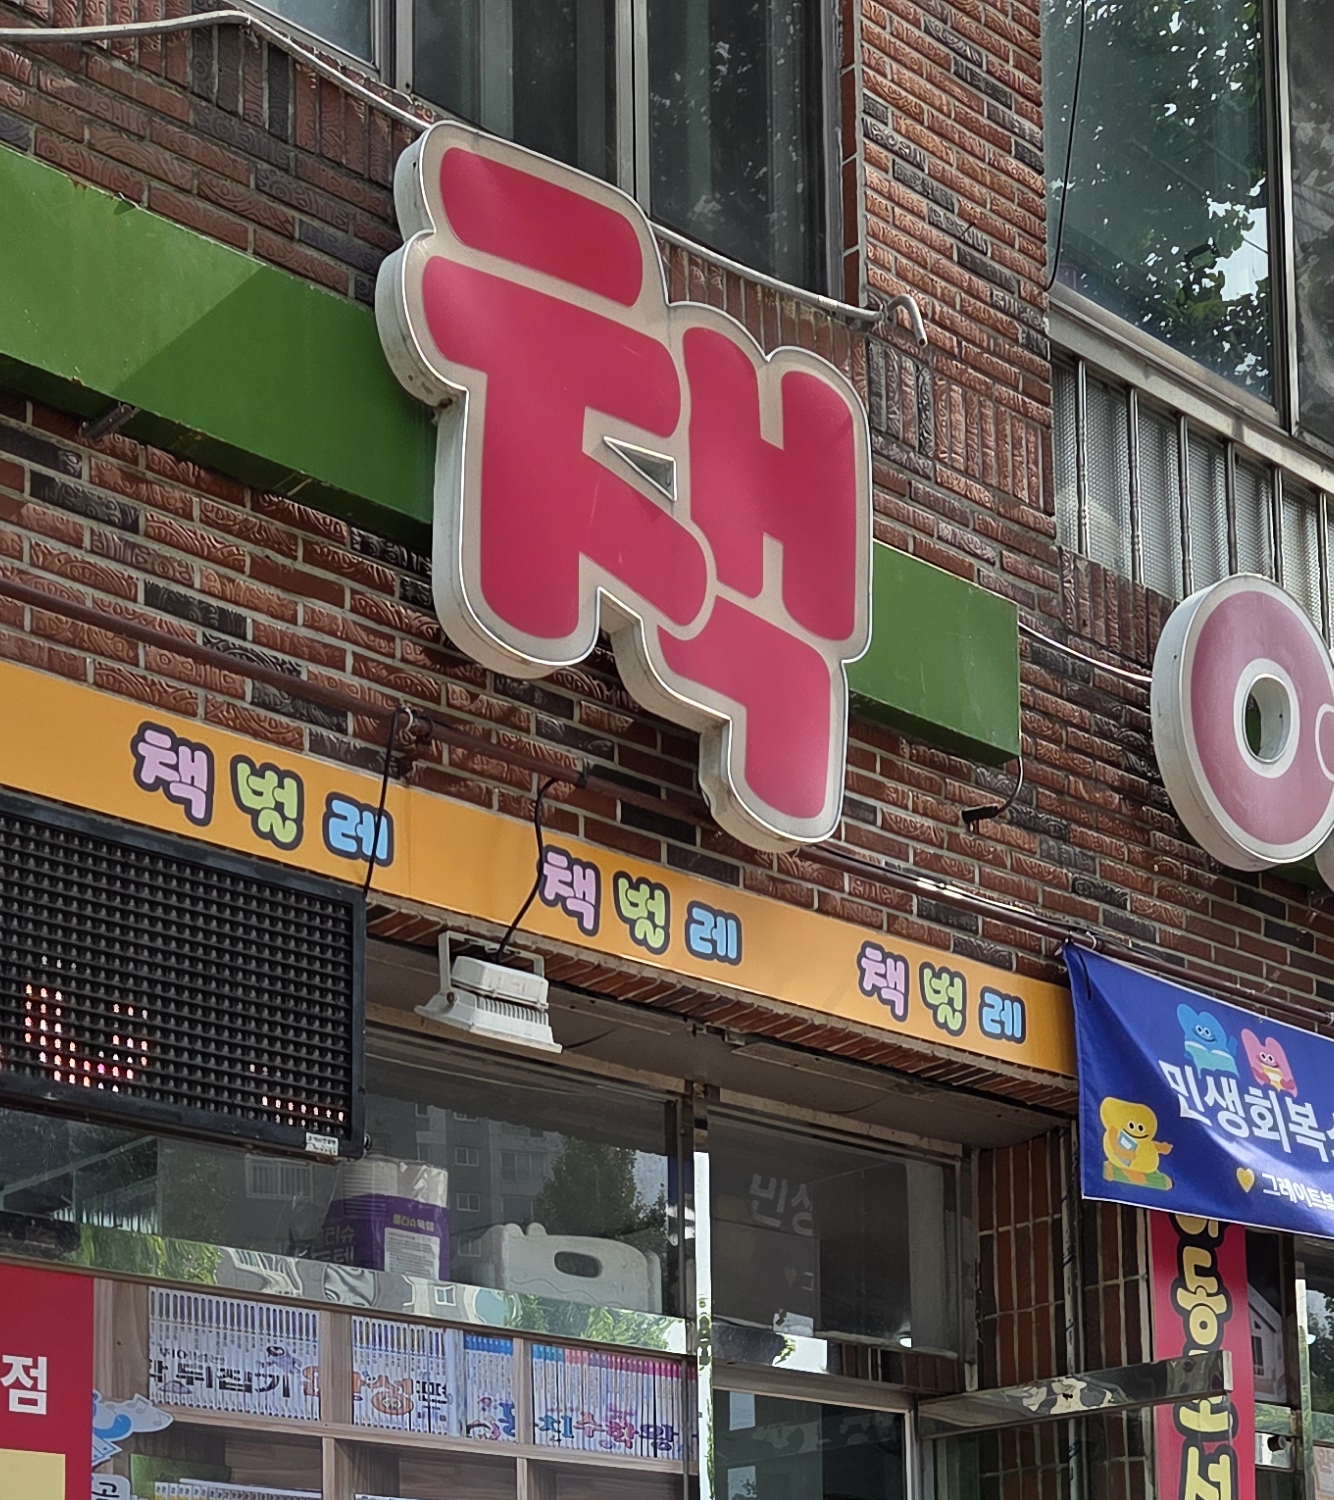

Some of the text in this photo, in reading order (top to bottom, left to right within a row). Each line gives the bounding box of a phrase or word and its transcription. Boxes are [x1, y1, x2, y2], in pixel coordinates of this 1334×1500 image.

[402, 120, 873, 846] 책
[131, 722, 394, 868] 책벌레
[539, 845, 742, 965] 책벌레
[858, 940, 1026, 1043] 책벌레
